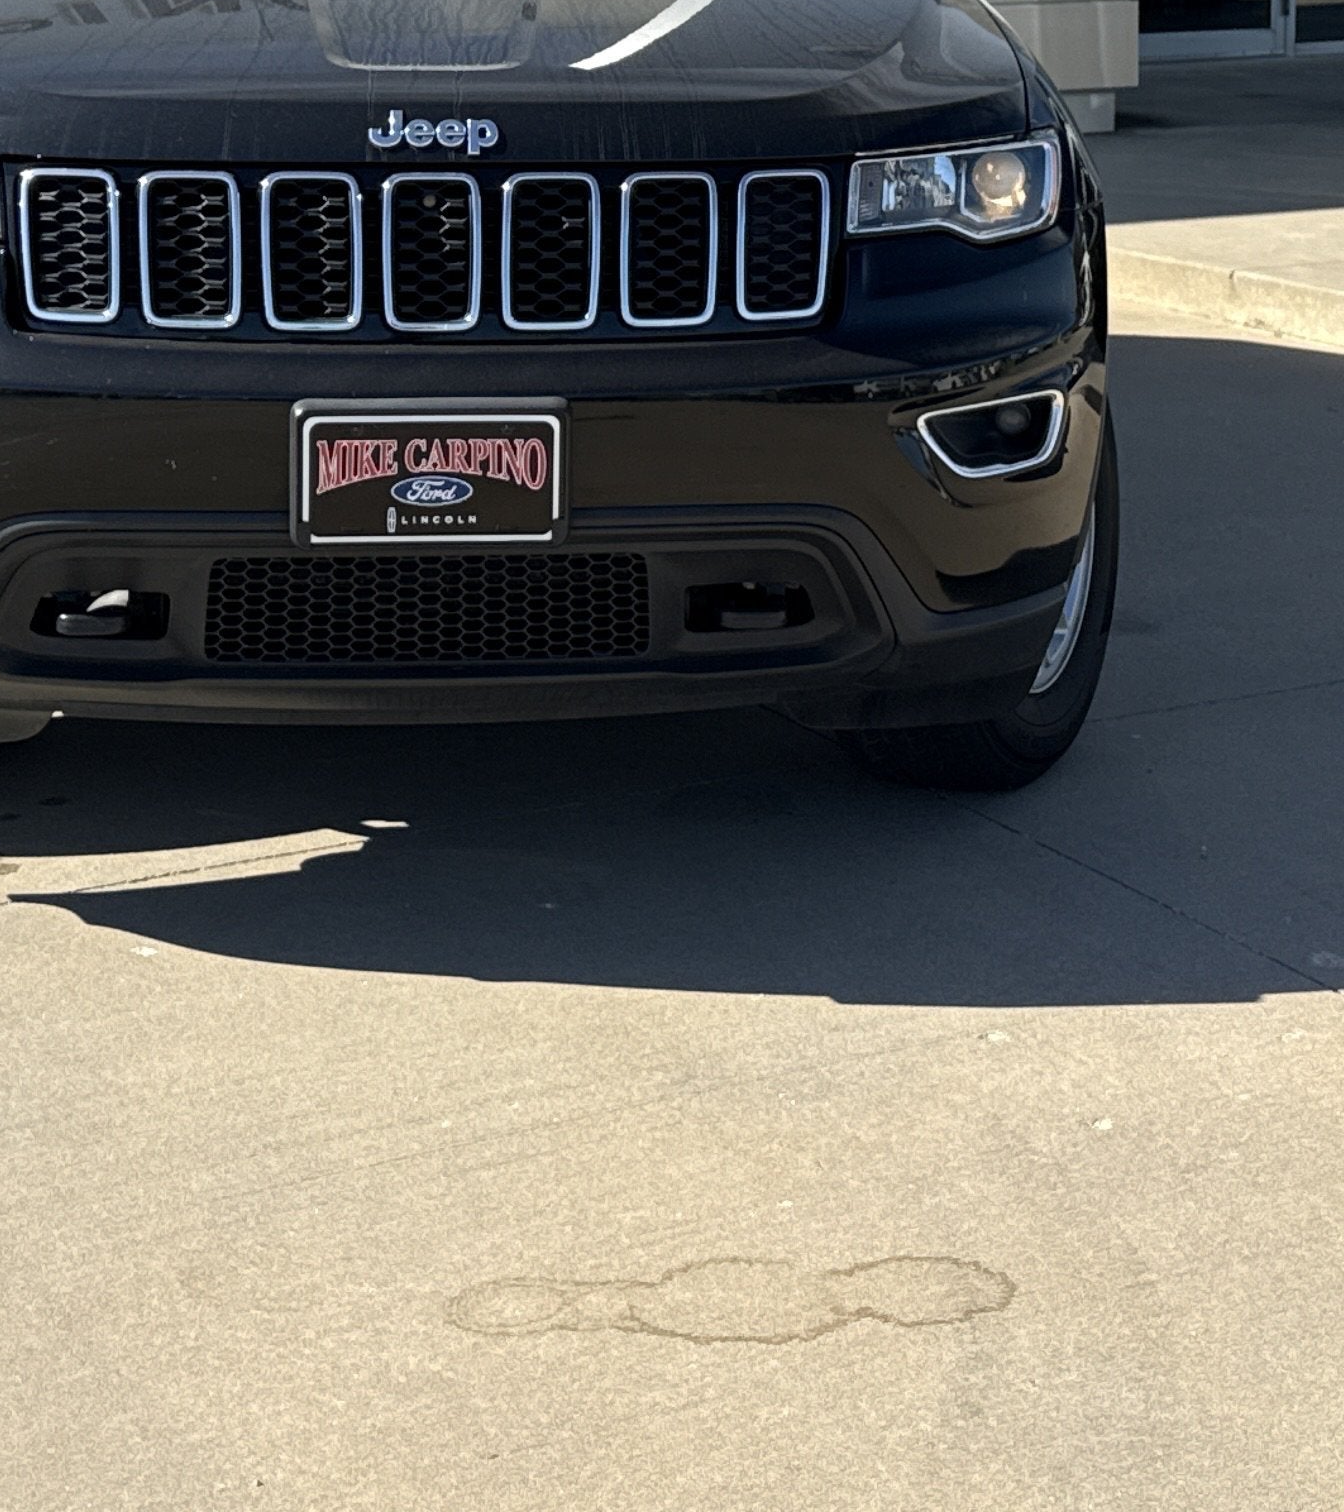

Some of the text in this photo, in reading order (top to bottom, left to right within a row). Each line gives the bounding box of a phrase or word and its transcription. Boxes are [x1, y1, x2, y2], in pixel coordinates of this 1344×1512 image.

[368, 109, 499, 156] Jeep
[316, 437, 548, 495] MIKE CARPINO
[406, 480, 458, 501] Ford
[400, 515, 477, 526] LINCOLN
